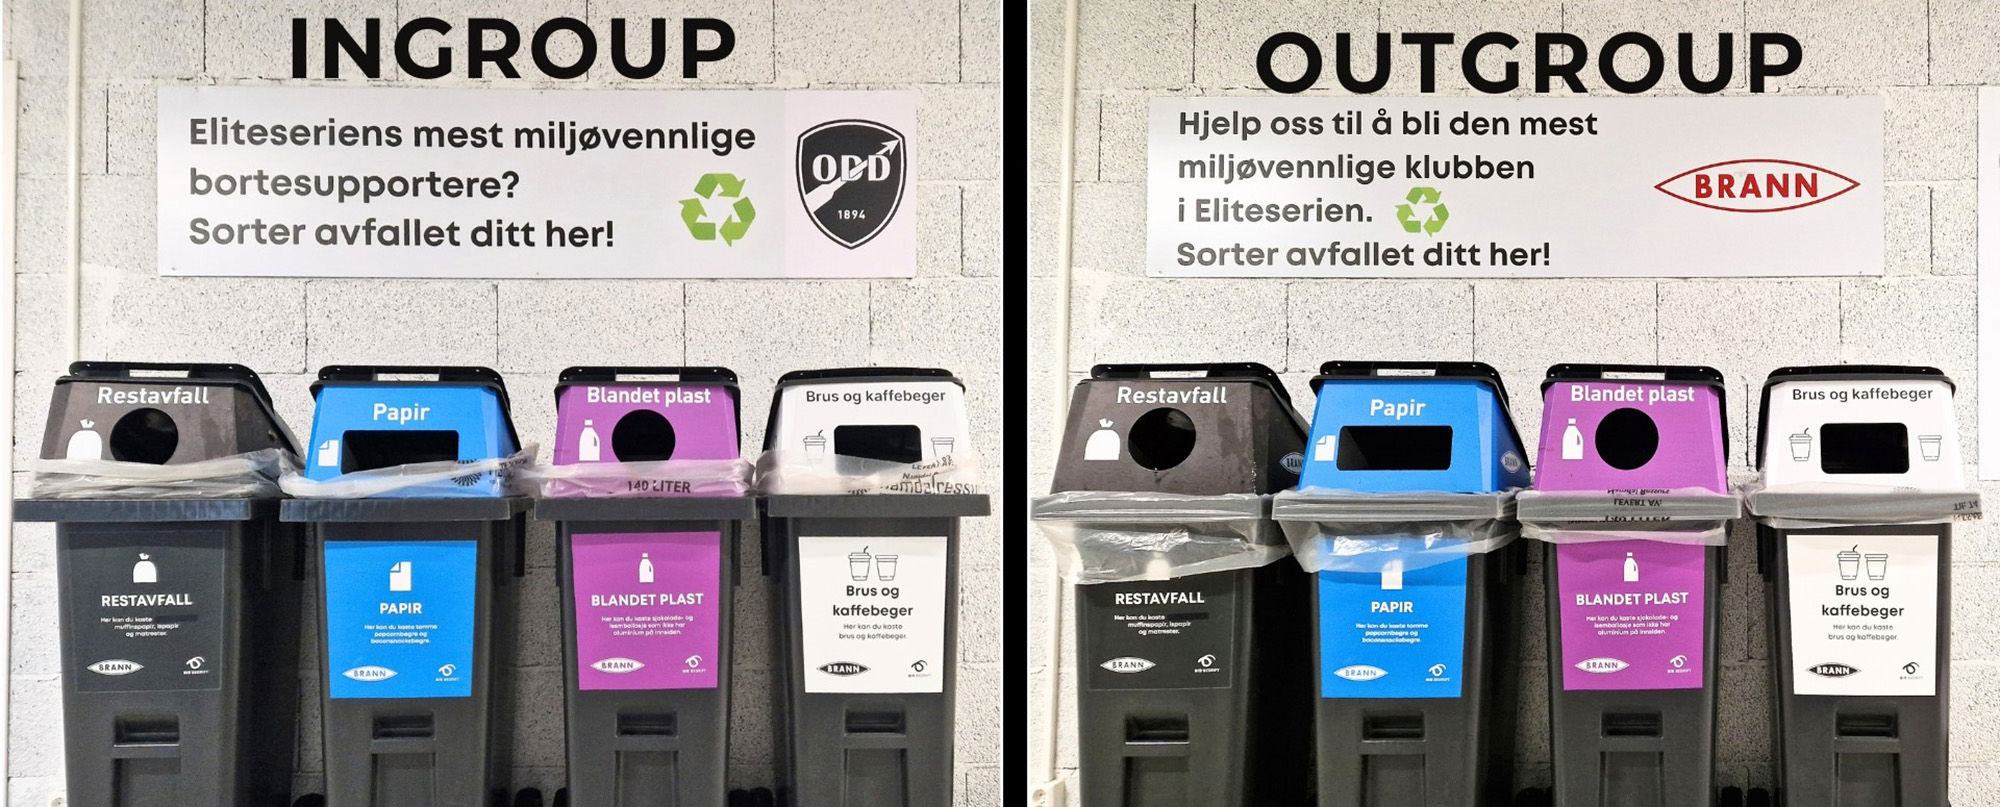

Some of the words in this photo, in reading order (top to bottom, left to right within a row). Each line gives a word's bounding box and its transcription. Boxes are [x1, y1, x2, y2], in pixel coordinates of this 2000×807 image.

[1180, 111, 1261, 140] Hjelp
[1271, 117, 1323, 135] oss
[1332, 111, 1361, 134] til
[1372, 108, 1391, 135] å
[1403, 111, 1439, 135] bli
[1450, 111, 1509, 135] den
[1521, 113, 1597, 135] mest
[191, 117, 402, 147] Eliteseriens
[415, 123, 503, 148] mest
[515, 121, 755, 156] miljøvennlige
[813, 154, 891, 182] ODD
[1180, 154, 1395, 184] miljøvennlige
[1406, 155, 1533, 179] klubben
[191, 168, 519, 203] bortesupportere?
[1695, 174, 1819, 199] BRANN
[838, 210, 865, 219] 1894
[1179, 198, 1184, 222] i
[1197, 198, 1372, 222] Eliteserien.
[190, 218, 305, 245] Sorter
[316, 218, 460, 246] avfallet
[471, 220, 535, 247] ditt
[547, 220, 613, 247] her!
[1178, 243, 1278, 266] Sorter
[1287, 242, 1414, 266] avfallet
[1424, 242, 1480, 266] ditt
[1491, 242, 1549, 266] her!
[97, 387, 209, 404] Restavfall
[588, 387, 659, 403] Blandet
[666, 388, 711, 407] plast
[806, 391, 838, 402] Brus
[844, 393, 861, 404] og
[866, 390, 946, 404] kaffebeger
[1118, 387, 1227, 404] Restavfall
[1572, 386, 1644, 401] Blandet
[1649, 386, 1695, 405] plast
[1793, 389, 1825, 400] Brus
[1830, 391, 1848, 402] og
[1853, 388, 1933, 402] kaffebeger
[373, 403, 430, 424] Papir
[1370, 399, 1426, 420] Papir
[628, 481, 649, 491] 140
[653, 481, 691, 493] LITER
[846, 586, 877, 596] Brus
[881, 587, 899, 599] og
[1115, 592, 1205, 605] RESTAVFALL
[1836, 585, 1867, 596] Brus
[1871, 587, 1889, 598] og
[101, 594, 193, 607] RESTAVFALL
[592, 594, 656, 607] BLANDET
[660, 593, 703, 605] PLAST
[1576, 593, 1641, 606] BLANDET
[1645, 592, 1688, 604] PLAST
[380, 603, 422, 614] PAPIR
[833, 605, 913, 619] kaffebeger
[1371, 602, 1413, 613] PAPIR
[1822, 605, 1904, 619] kaffebeger
[828, 665, 860, 673] BRANN
[1817, 666, 1850, 674] BRANN
